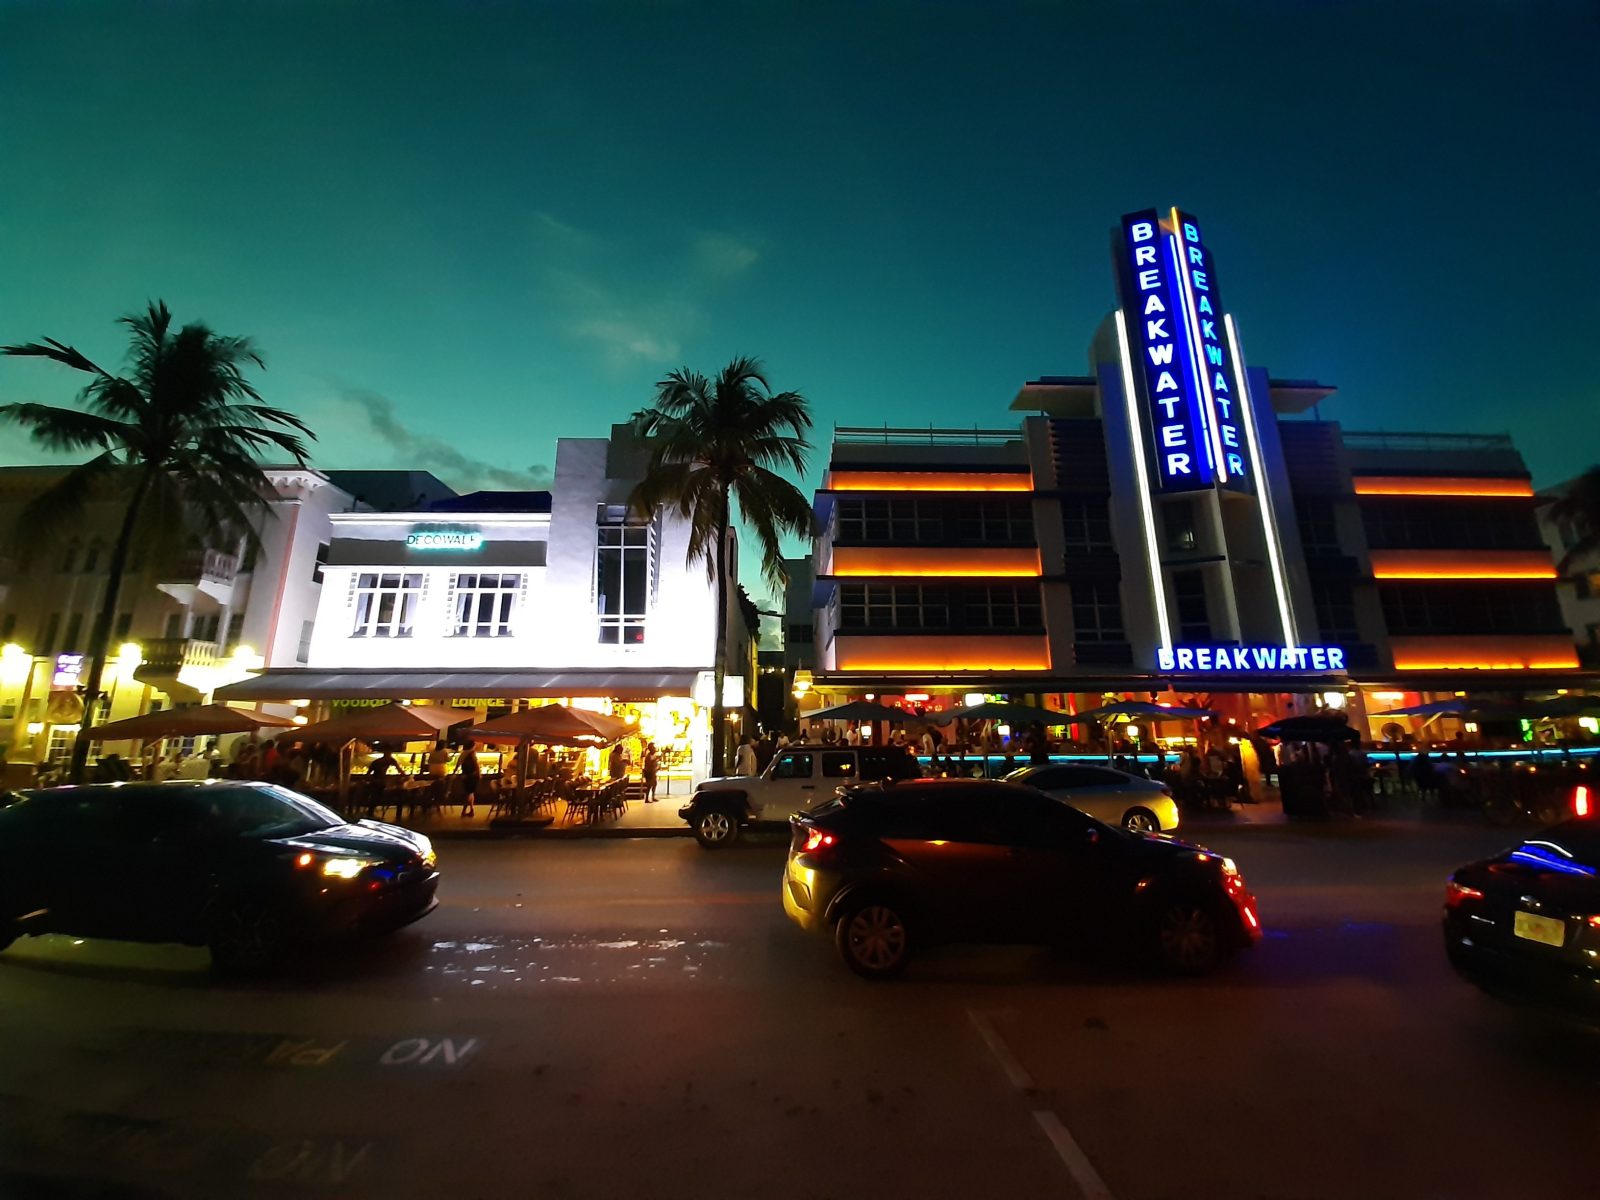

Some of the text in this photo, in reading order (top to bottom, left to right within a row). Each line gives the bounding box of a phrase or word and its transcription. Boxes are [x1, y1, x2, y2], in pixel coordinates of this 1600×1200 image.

[1131, 222, 1192, 476] BREAKWATER
[1183, 222, 1245, 477] BREAKWATER
[451, 697, 505, 707] LOUNGE
[1157, 647, 1345, 670] BREAKWATER
